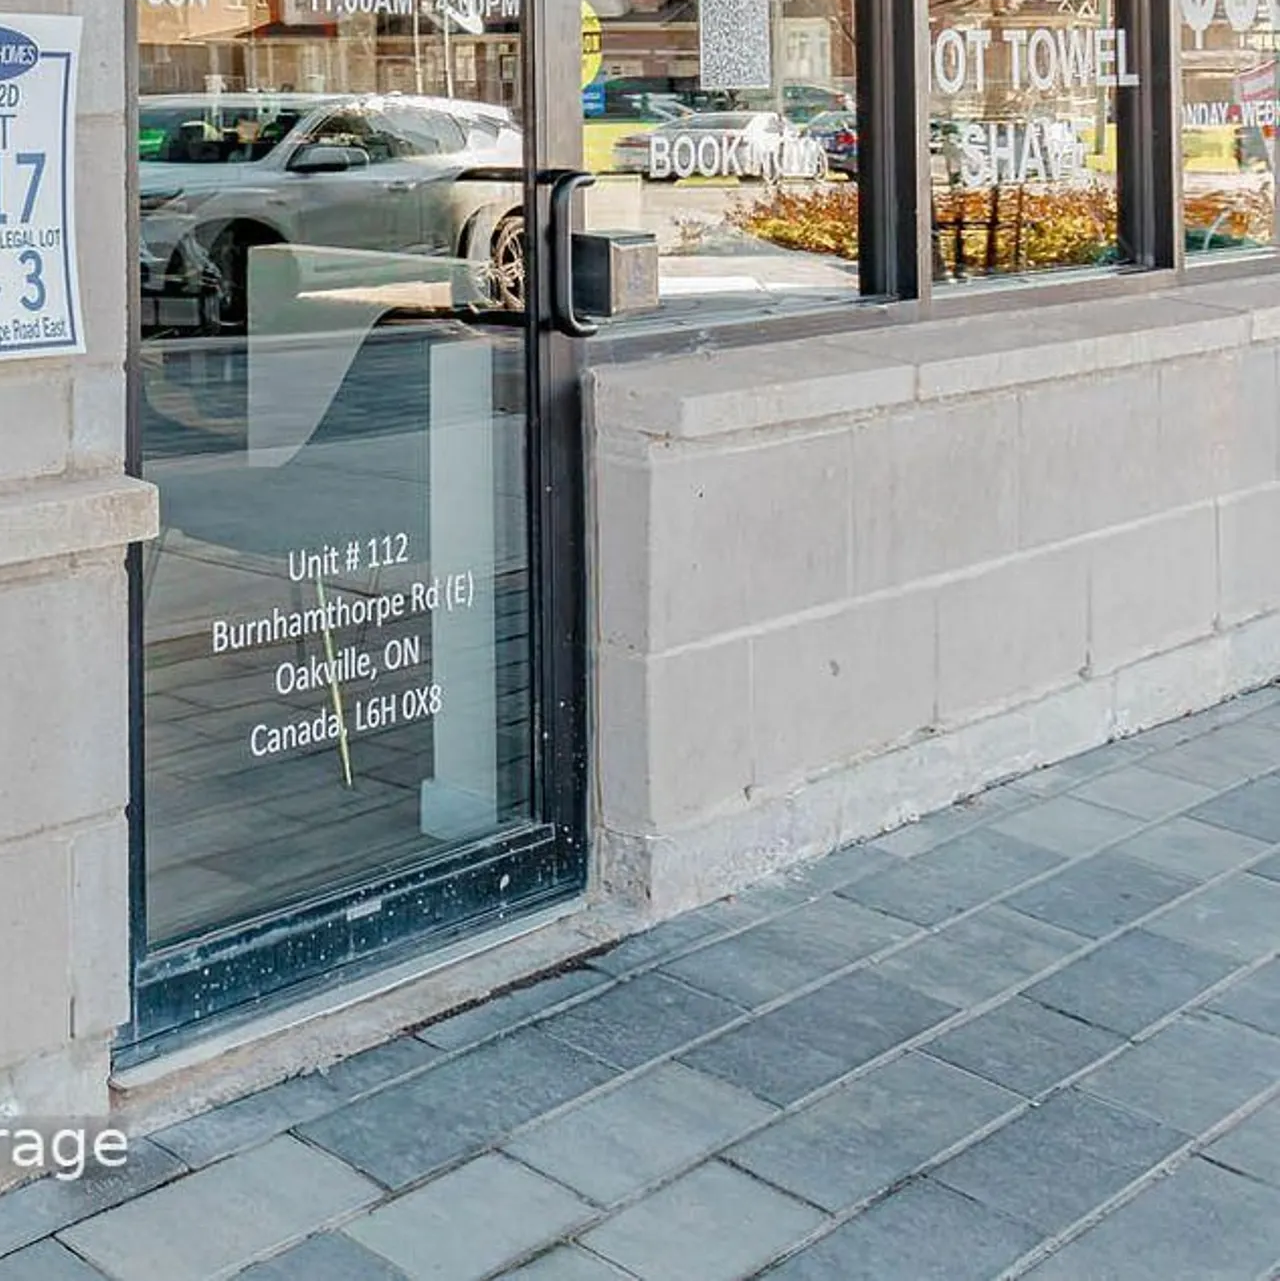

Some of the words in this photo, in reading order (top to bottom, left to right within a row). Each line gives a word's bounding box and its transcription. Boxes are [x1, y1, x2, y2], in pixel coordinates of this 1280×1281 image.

[929, 28, 991, 96] OT
[1003, 28, 1139, 93] TOWEL
[650, 135, 744, 179] BOOK
[39, 228, 61, 248] LOT
[19, 249, 47, 312] 3
[13, 319, 39, 340] Road
[42, 317, 67, 338] East
[289, 545, 339, 581] Unit
[346, 542, 360, 571] #
[367, 532, 409, 568] 112
[212, 593, 404, 653] Burnhamthorpe
[411, 580, 439, 612] Rd
[445, 570, 474, 612] (E)
[275, 646, 378, 695] Oakville,
[384, 635, 421, 670] ON
[251, 708, 348, 757] Canada,
[356, 694, 396, 731] L6H
